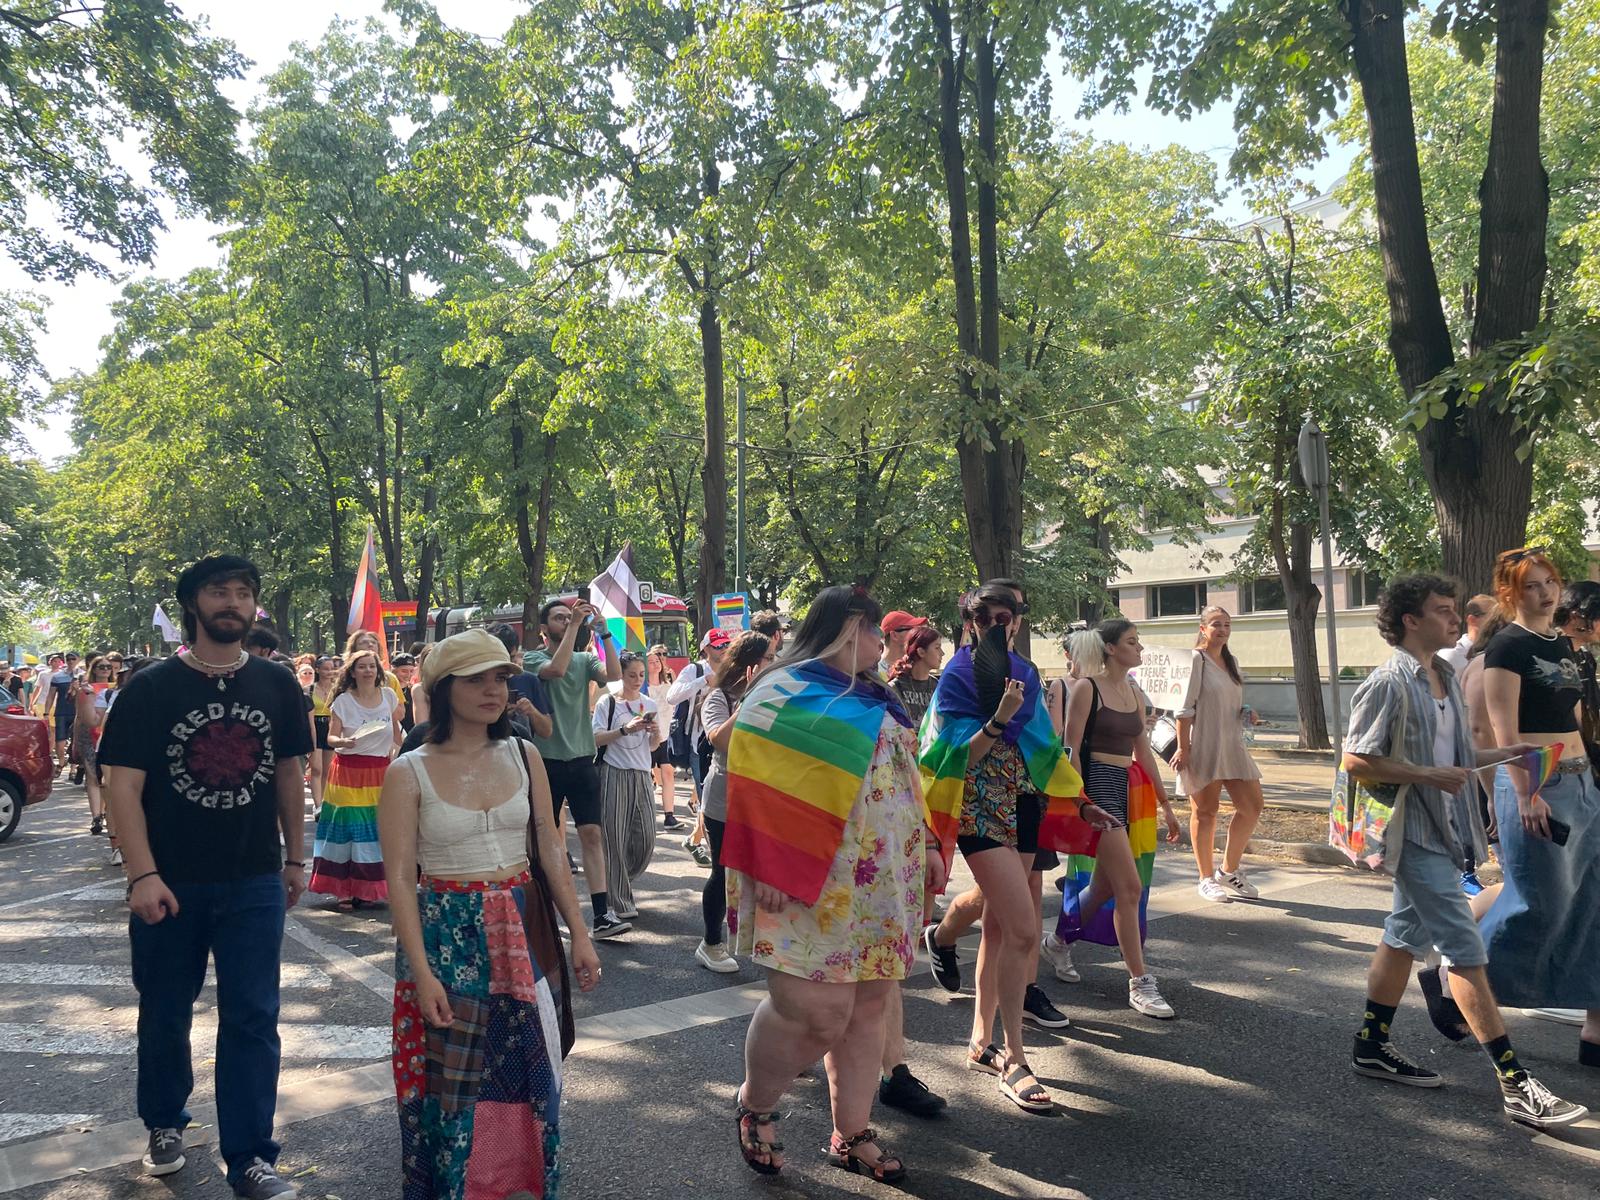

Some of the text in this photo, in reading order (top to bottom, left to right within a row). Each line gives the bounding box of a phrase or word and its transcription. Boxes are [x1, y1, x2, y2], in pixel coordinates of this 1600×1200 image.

[642, 589, 650, 599] 6
[171, 703, 225, 742] RED
[231, 702, 272, 733] HOT
[166, 744, 252, 809] PEPPERS
